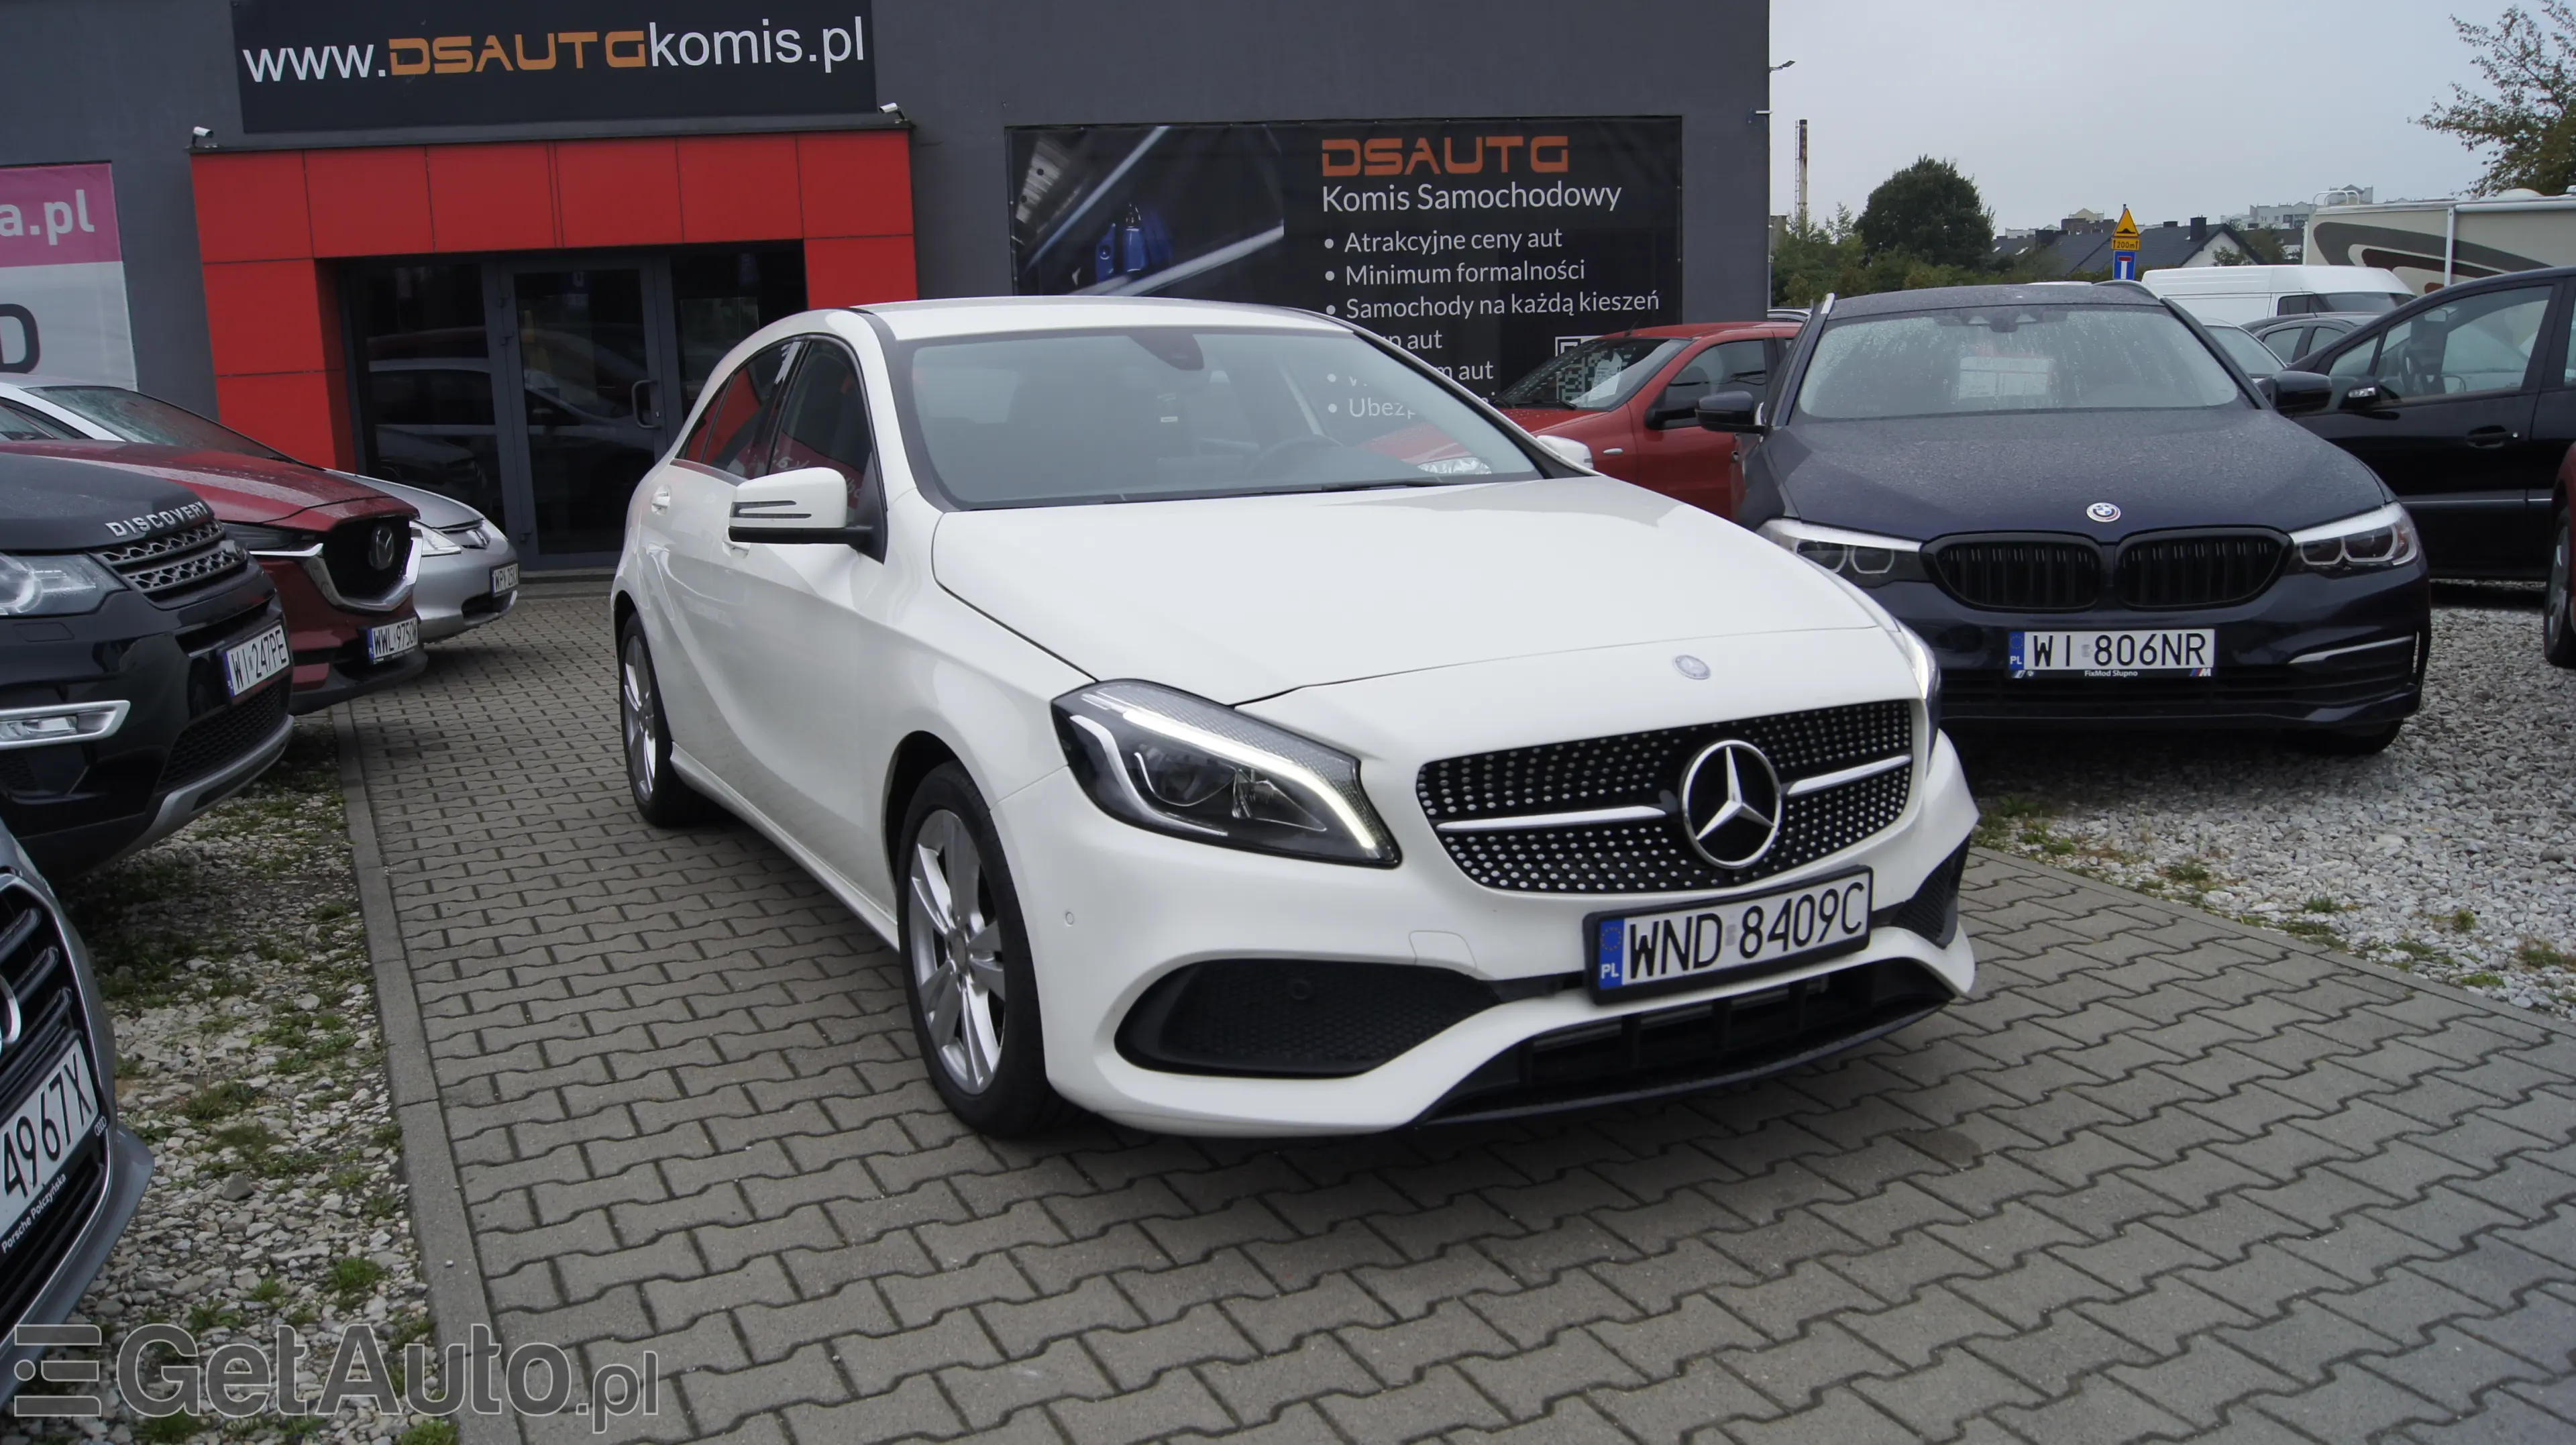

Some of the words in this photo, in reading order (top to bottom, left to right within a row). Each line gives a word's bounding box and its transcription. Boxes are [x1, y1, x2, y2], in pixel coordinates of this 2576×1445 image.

[1322, 184, 1410, 213] Komis
[1417, 180, 1622, 211] Samochodowy
[1344, 229, 1466, 255] Atrakcyjne
[1470, 233, 1523, 252] ceny
[1527, 228, 1563, 248] aut
[1346, 264, 1452, 286] Minimum
[1456, 259, 1585, 283] formalności
[1346, 295, 1474, 320] Samochody
[1479, 299, 1505, 315] na
[1511, 292, 1575, 317] każdą
[1579, 290, 1660, 312] kieszeń
[1407, 329, 1443, 350] aut
[1458, 360, 1494, 380] aut
[105, 501, 208, 537] DISCOVERY
[251, 629, 287, 679] 247PE
[374, 627, 394, 656] WWL
[2010, 655, 2023, 665] PL
[2033, 635, 2071, 667] WI
[2094, 633, 2206, 666] 806NR
[1601, 962, 1620, 979] PL
[1629, 912, 1723, 980] WND
[1739, 881, 1866, 959] 8409C
[3, 1051, 92, 1199] 4967X
[1, 1217, 32, 1253] Porsche
